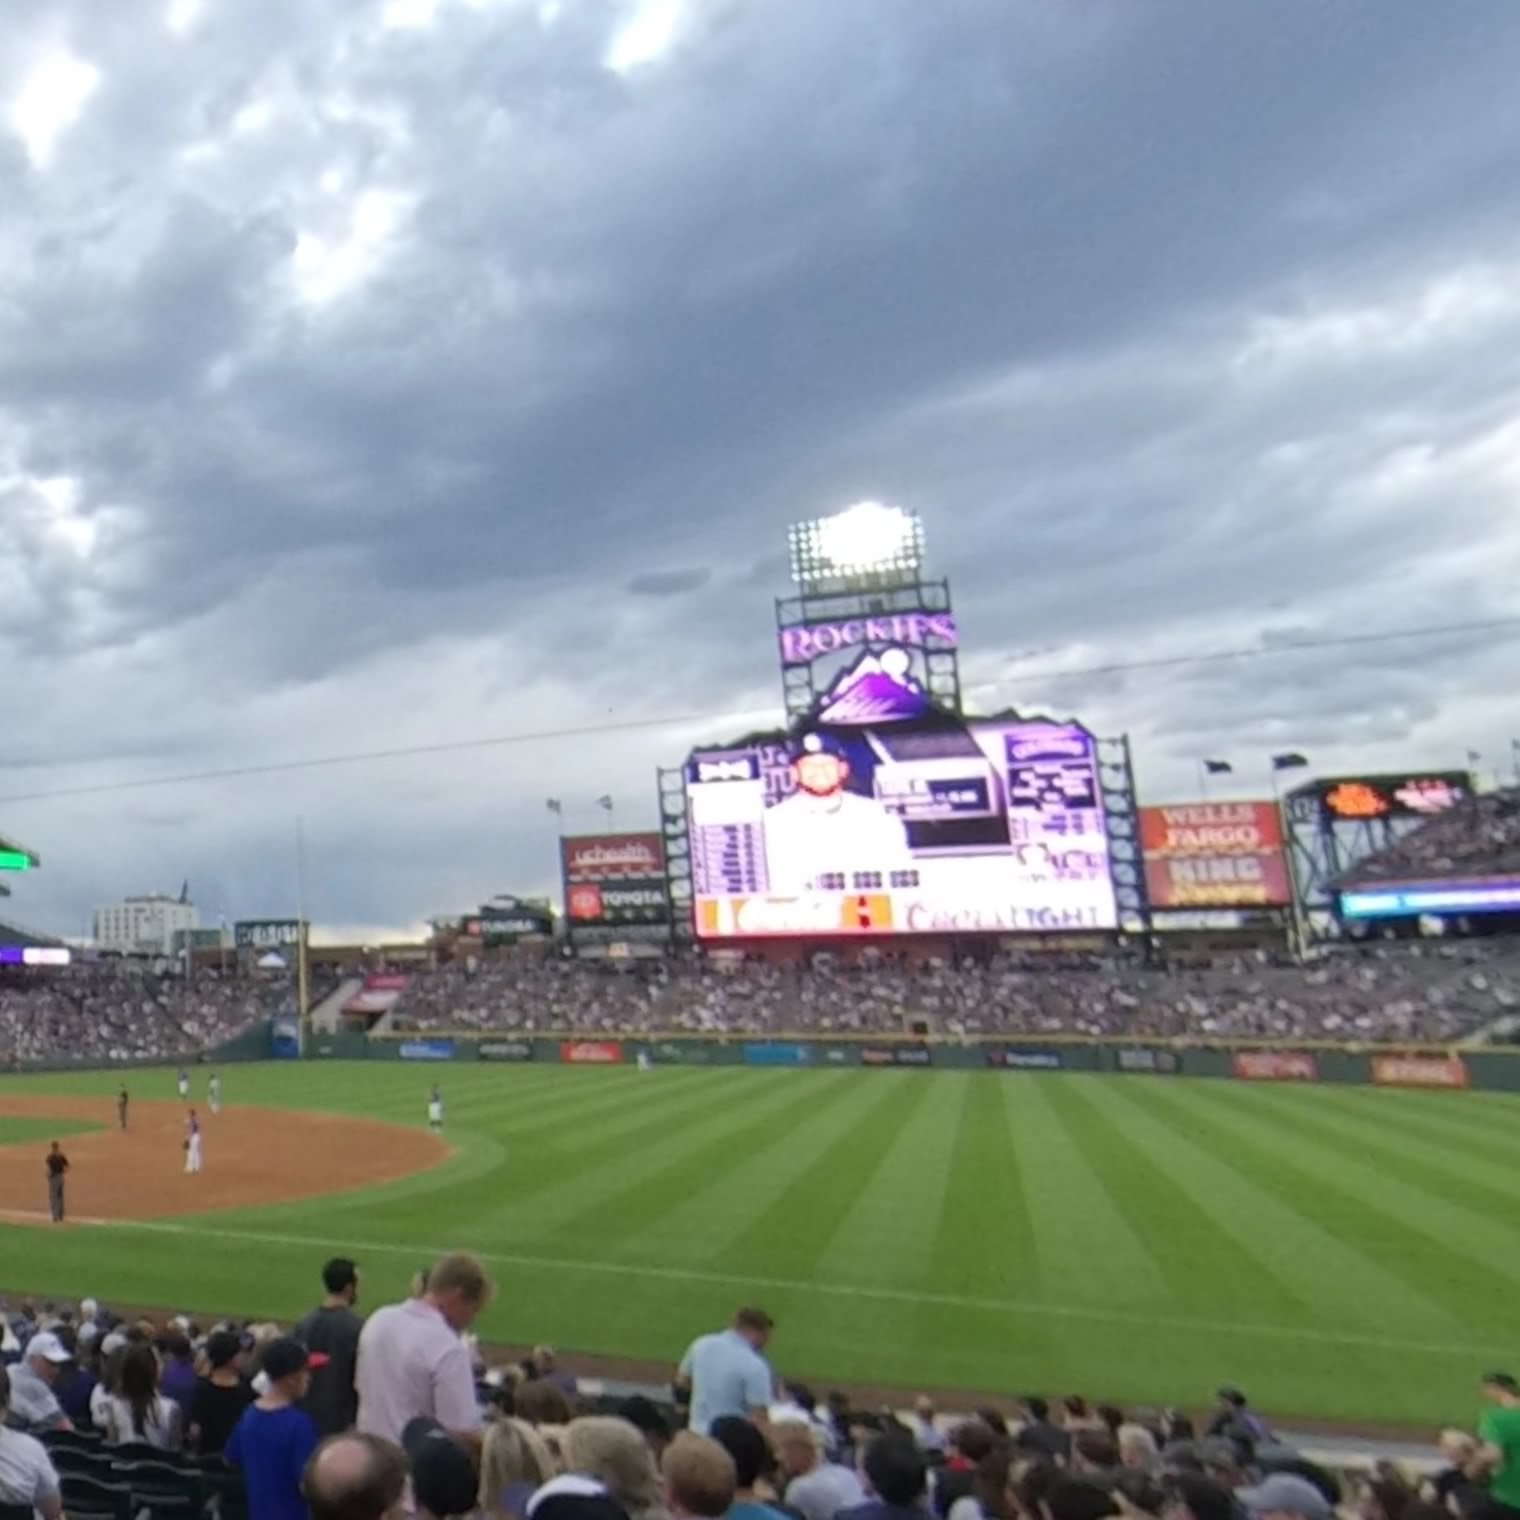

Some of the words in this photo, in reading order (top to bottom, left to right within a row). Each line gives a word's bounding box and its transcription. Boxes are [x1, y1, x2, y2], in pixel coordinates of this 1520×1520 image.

[782, 613, 959, 664] ROCKIES
[1161, 804, 1256, 824] WELLS
[1166, 825, 1260, 849] FARGO
[601, 890, 664, 907] TOYOTA
